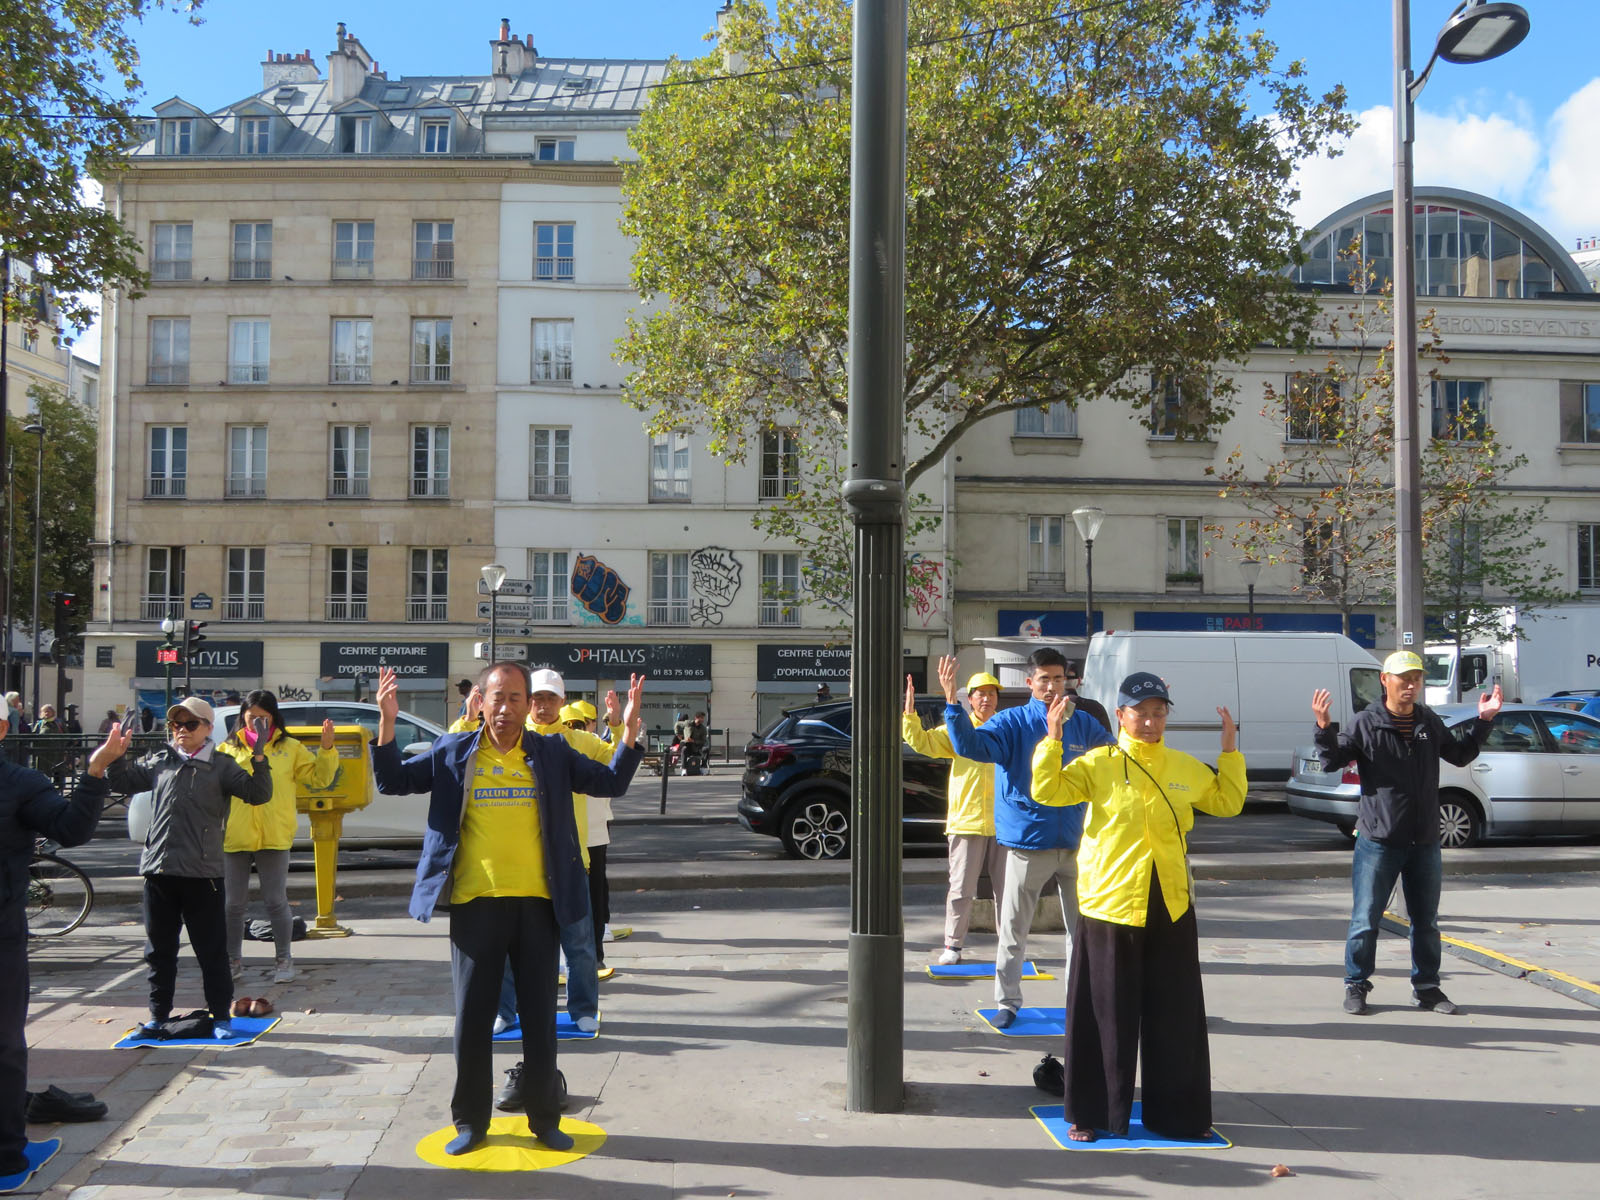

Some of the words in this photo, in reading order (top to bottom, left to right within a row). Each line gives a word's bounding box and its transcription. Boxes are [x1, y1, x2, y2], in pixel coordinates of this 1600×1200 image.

[1438, 316, 1591, 336] RRONDISSEMENTS
[1224, 617, 1264, 630] PARS
[339, 646, 378, 655] CENTRE
[381, 647, 427, 655] DENTAIRE
[777, 649, 814, 657] CENTRE
[379, 656, 386, 664] &
[569, 648, 646, 663] OPHTALYS
[477, 789, 509, 798] FALUN
